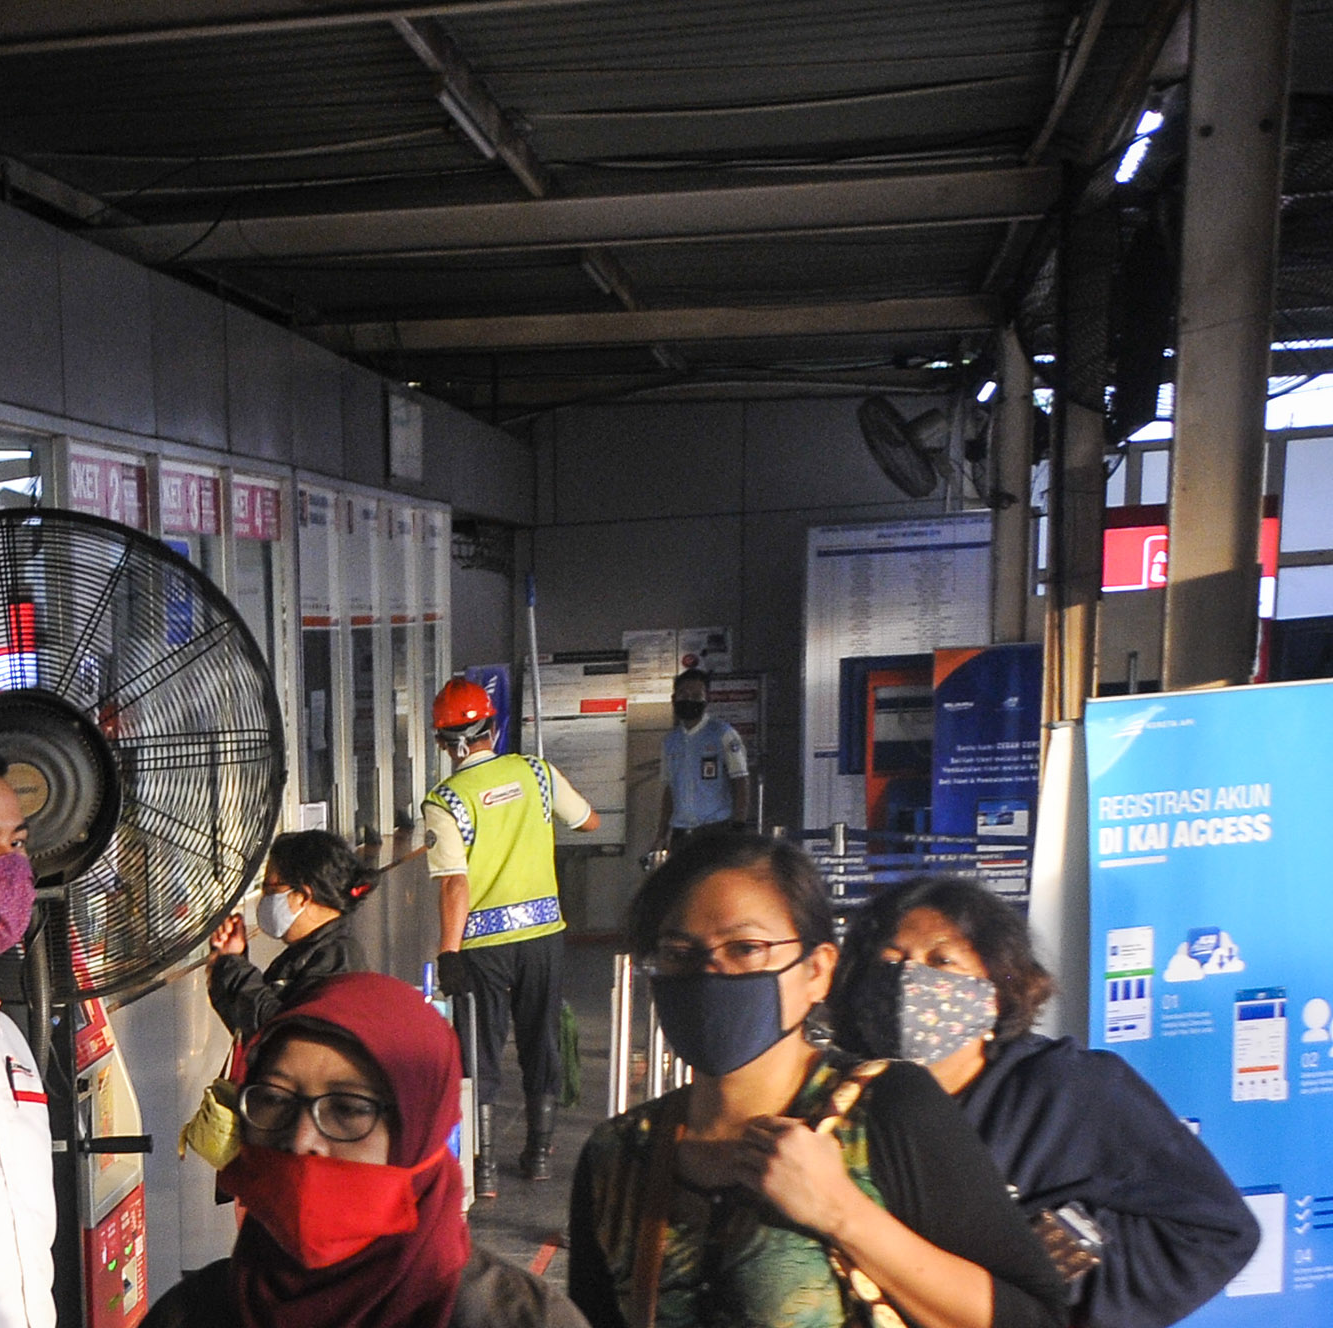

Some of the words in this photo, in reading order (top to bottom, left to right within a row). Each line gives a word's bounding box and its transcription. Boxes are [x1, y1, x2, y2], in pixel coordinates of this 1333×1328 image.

[70, 461, 100, 499] OKET
[1098, 788, 1212, 821] REGISTRASI
[1213, 783, 1273, 811] AKUN
[1097, 826, 1124, 855] DI
[1127, 822, 1169, 852] KAI
[1171, 813, 1273, 849] ACCESS
[1301, 1052, 1320, 1068] 02
[1295, 1248, 1312, 1264] 04
